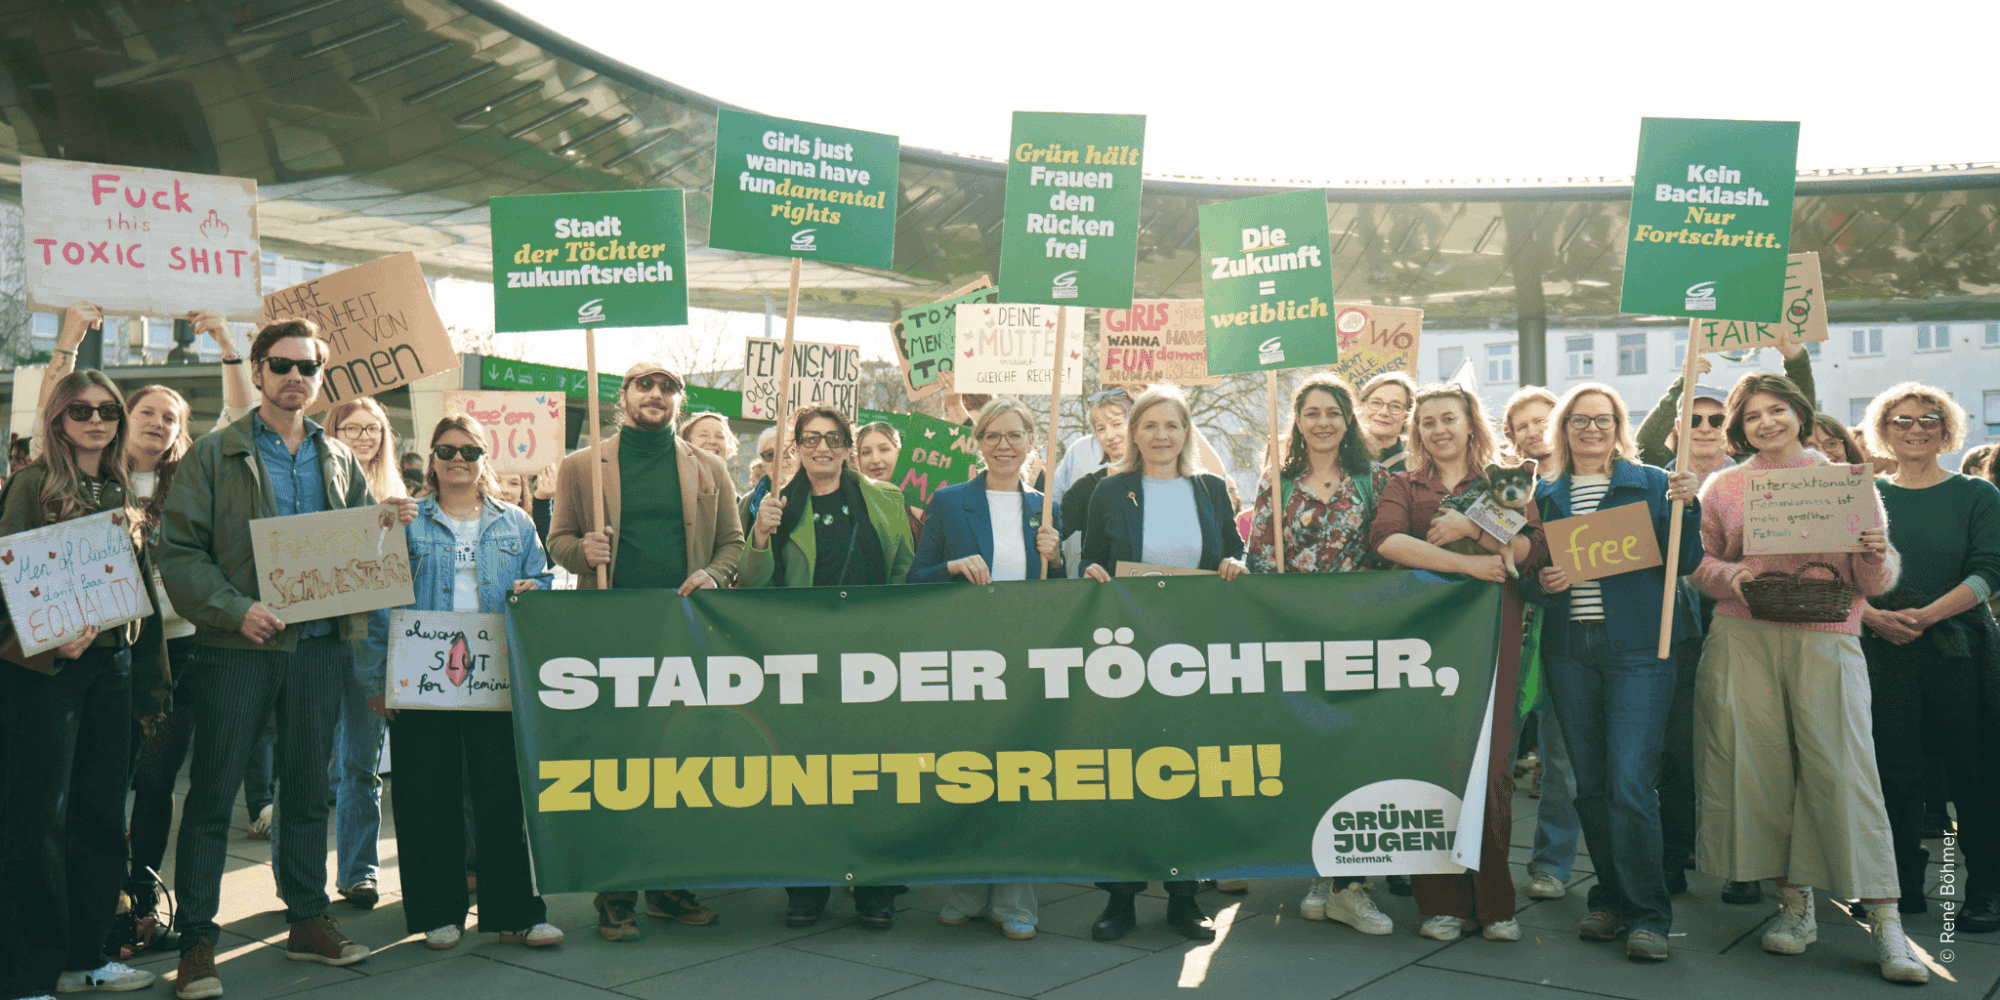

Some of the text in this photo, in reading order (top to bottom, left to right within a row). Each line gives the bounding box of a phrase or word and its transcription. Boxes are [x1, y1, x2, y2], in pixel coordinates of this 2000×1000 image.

[762, 131, 854, 161] Girls just
[1015, 143, 1140, 166] Grün hält
[746, 153, 870, 186] wanna have
[1030, 166, 1113, 188] Frauen
[1687, 164, 1741, 184] Kein
[92, 174, 193, 213] Fuck
[739, 171, 885, 209] fundamental
[1049, 190, 1095, 212] den
[1655, 183, 1769, 206] Backlash.
[107, 212, 151, 232] this
[771, 201, 841, 225] rights
[1026, 212, 1114, 237] Rücken
[1684, 206, 1736, 225] Nur
[554, 216, 622, 239] Stadt
[1241, 225, 1287, 250] Die
[1634, 224, 1782, 249] Fortschritt.
[33, 239, 248, 278] TOXIC SHIT
[513, 239, 666, 265] der Töchter
[1045, 237, 1087, 259] frei
[507, 261, 673, 288] zukunftsreich
[1211, 245, 1322, 280] Zukunft
[1259, 280, 1276, 296] =
[304, 291, 377, 331] ÖNHEIT
[998, 307, 1041, 327] DEINE
[1105, 303, 1169, 332] GIRLS
[1210, 296, 1329, 329] weiblich
[357, 309, 409, 343] VON
[1701, 321, 1775, 347] FAIR
[911, 333, 942, 358] MEN
[979, 329, 1067, 358] MUTTE
[1107, 335, 1161, 347] WANNA
[746, 340, 859, 382] FEMNISMUS
[1348, 357, 1378, 384] ALLE
[976, 366, 1072, 385] GLEICHE RECHE!
[745, 377, 776, 403] oder
[466, 400, 535, 426] fee'em
[911, 447, 952, 469] DEM
[900, 468, 948, 504] MA
[1751, 477, 1865, 492] Intersektionaler
[1838, 494, 1855, 506] ist
[1750, 514, 1779, 523] mein
[1753, 528, 1792, 539] Fetisch
[1565, 524, 1641, 571] free
[14, 554, 52, 584] Men
[58, 540, 76, 577] of
[268, 553, 411, 610] SCHWESTERN
[28, 577, 140, 644] EQUALITY
[405, 620, 494, 645] always a
[428, 650, 491, 672] SLUT
[538, 627, 1460, 710] STADT DER TÖCHTER,
[417, 673, 510, 696] for femini
[538, 743, 1284, 813] ZUKUNFTSREICH!
[1332, 803, 1444, 831] GRÜNE
[1335, 854, 1393, 864] Steiermark
